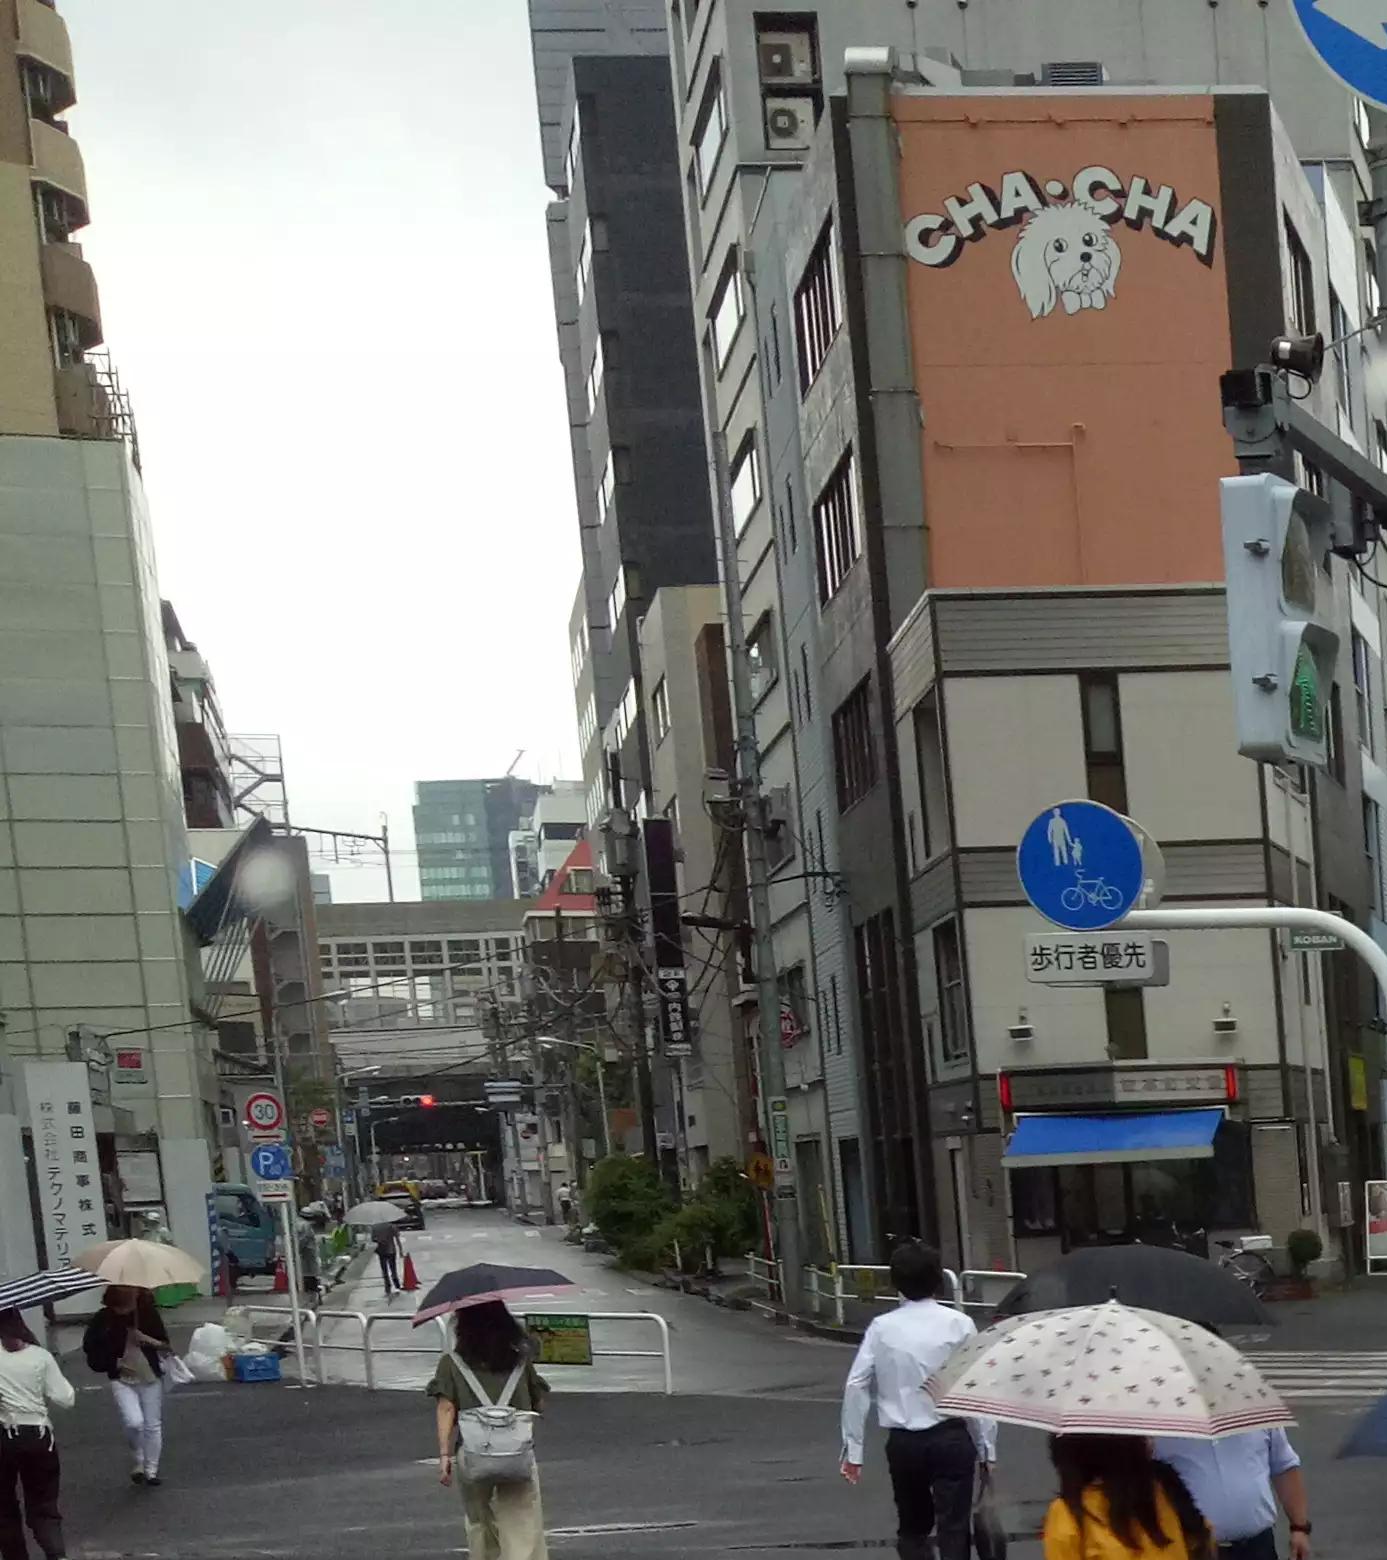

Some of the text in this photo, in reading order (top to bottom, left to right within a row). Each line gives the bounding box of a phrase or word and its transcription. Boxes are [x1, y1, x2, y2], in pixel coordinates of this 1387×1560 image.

[1031, 942, 1147, 971] 歩行者優先
[253, 1104, 276, 1120] 30
[259, 1152, 274, 1175] P
